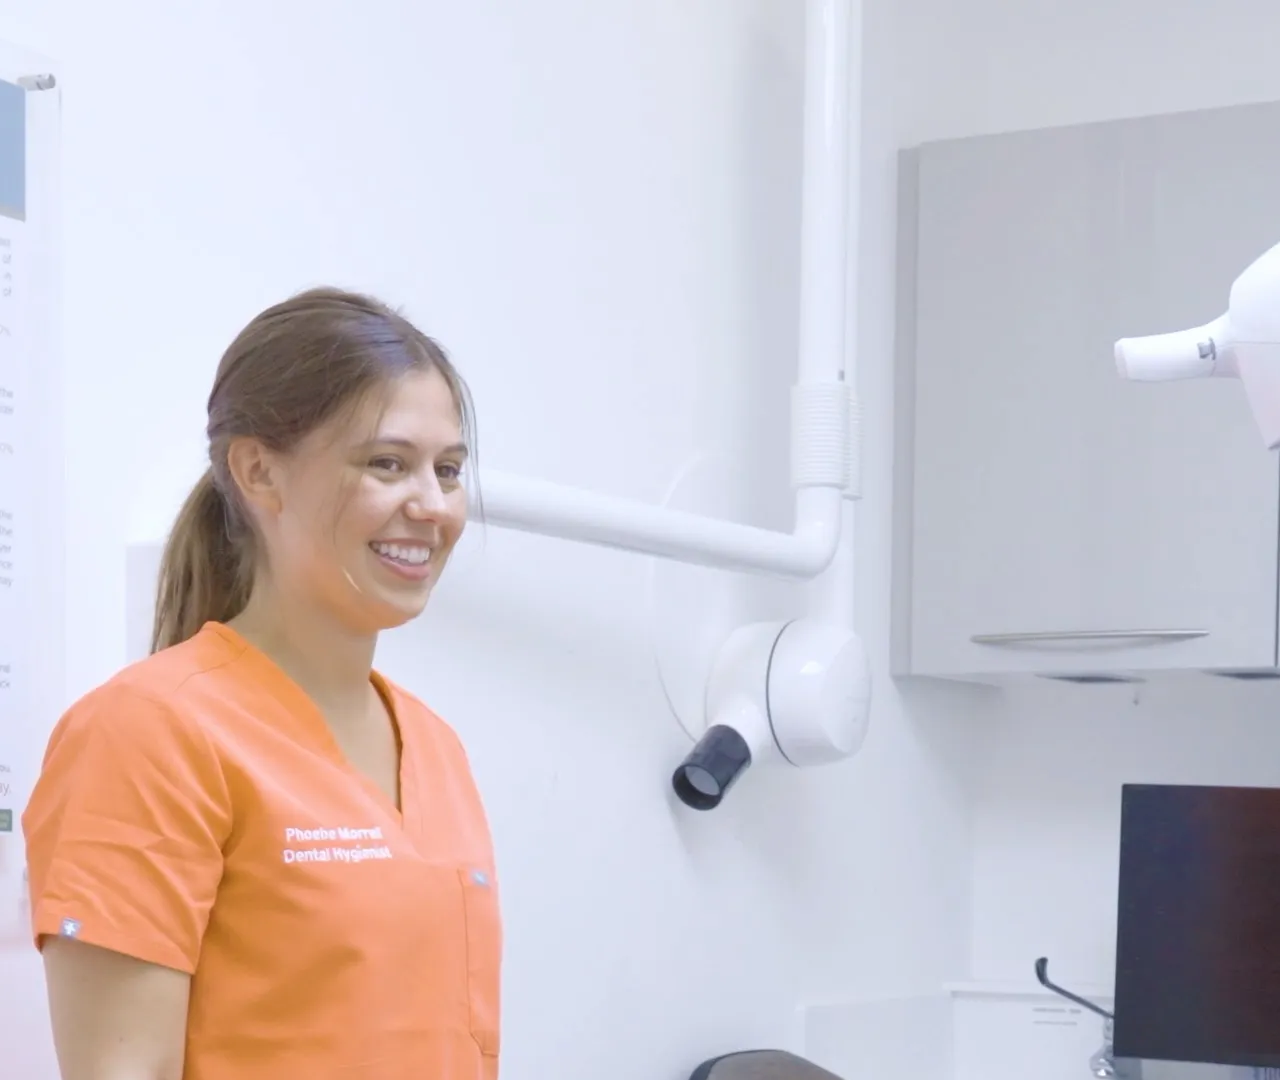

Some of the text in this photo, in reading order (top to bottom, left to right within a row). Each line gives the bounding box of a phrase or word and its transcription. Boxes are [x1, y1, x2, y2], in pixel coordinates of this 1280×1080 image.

[0, 385, 13, 398] the
[286, 827, 336, 842] Phoebe
[284, 844, 392, 863] Dental Hygienist
